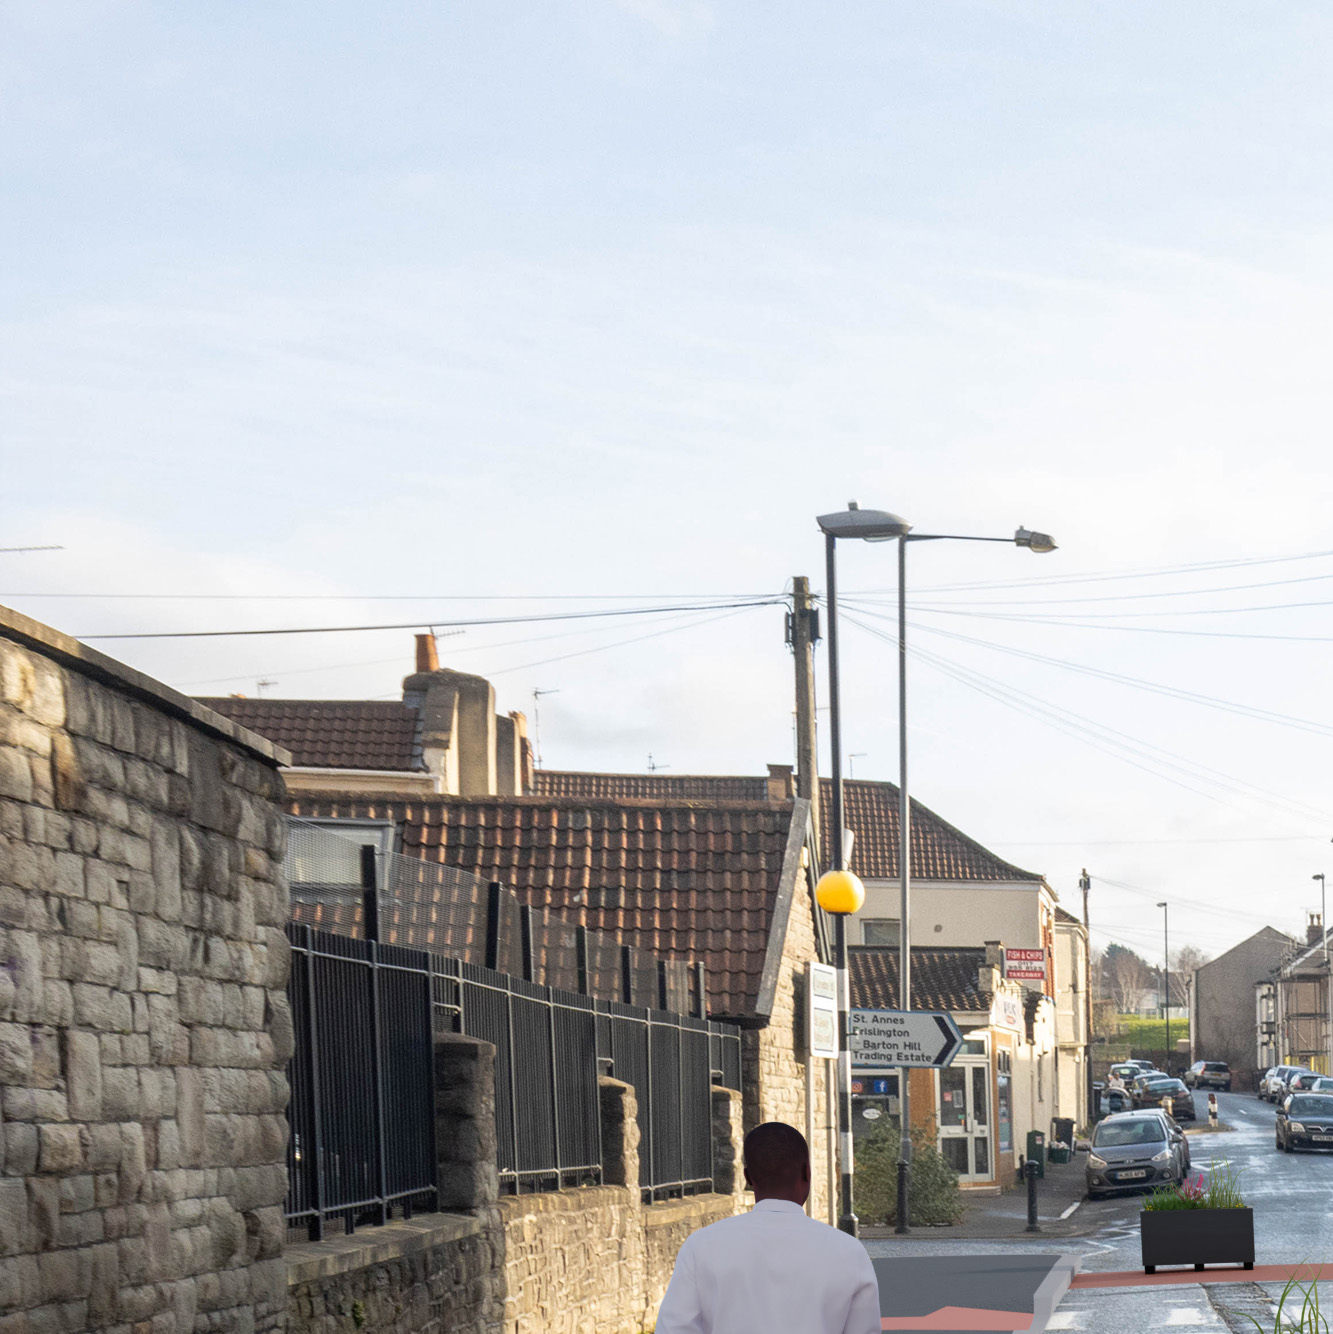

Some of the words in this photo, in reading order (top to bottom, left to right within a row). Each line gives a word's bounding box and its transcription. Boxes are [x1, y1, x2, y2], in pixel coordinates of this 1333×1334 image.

[1007, 951, 1021, 960] FISH
[1021, 951, 1026, 960] &
[1026, 951, 1043, 960] CHIPS
[853, 1014, 868, 1024] St.
[872, 1014, 905, 1024] Annes
[863, 1040, 899, 1050] Barton
[903, 1041, 921, 1051] Hill
[853, 1050, 892, 1062] Trading
[897, 1053, 932, 1062] Estate
